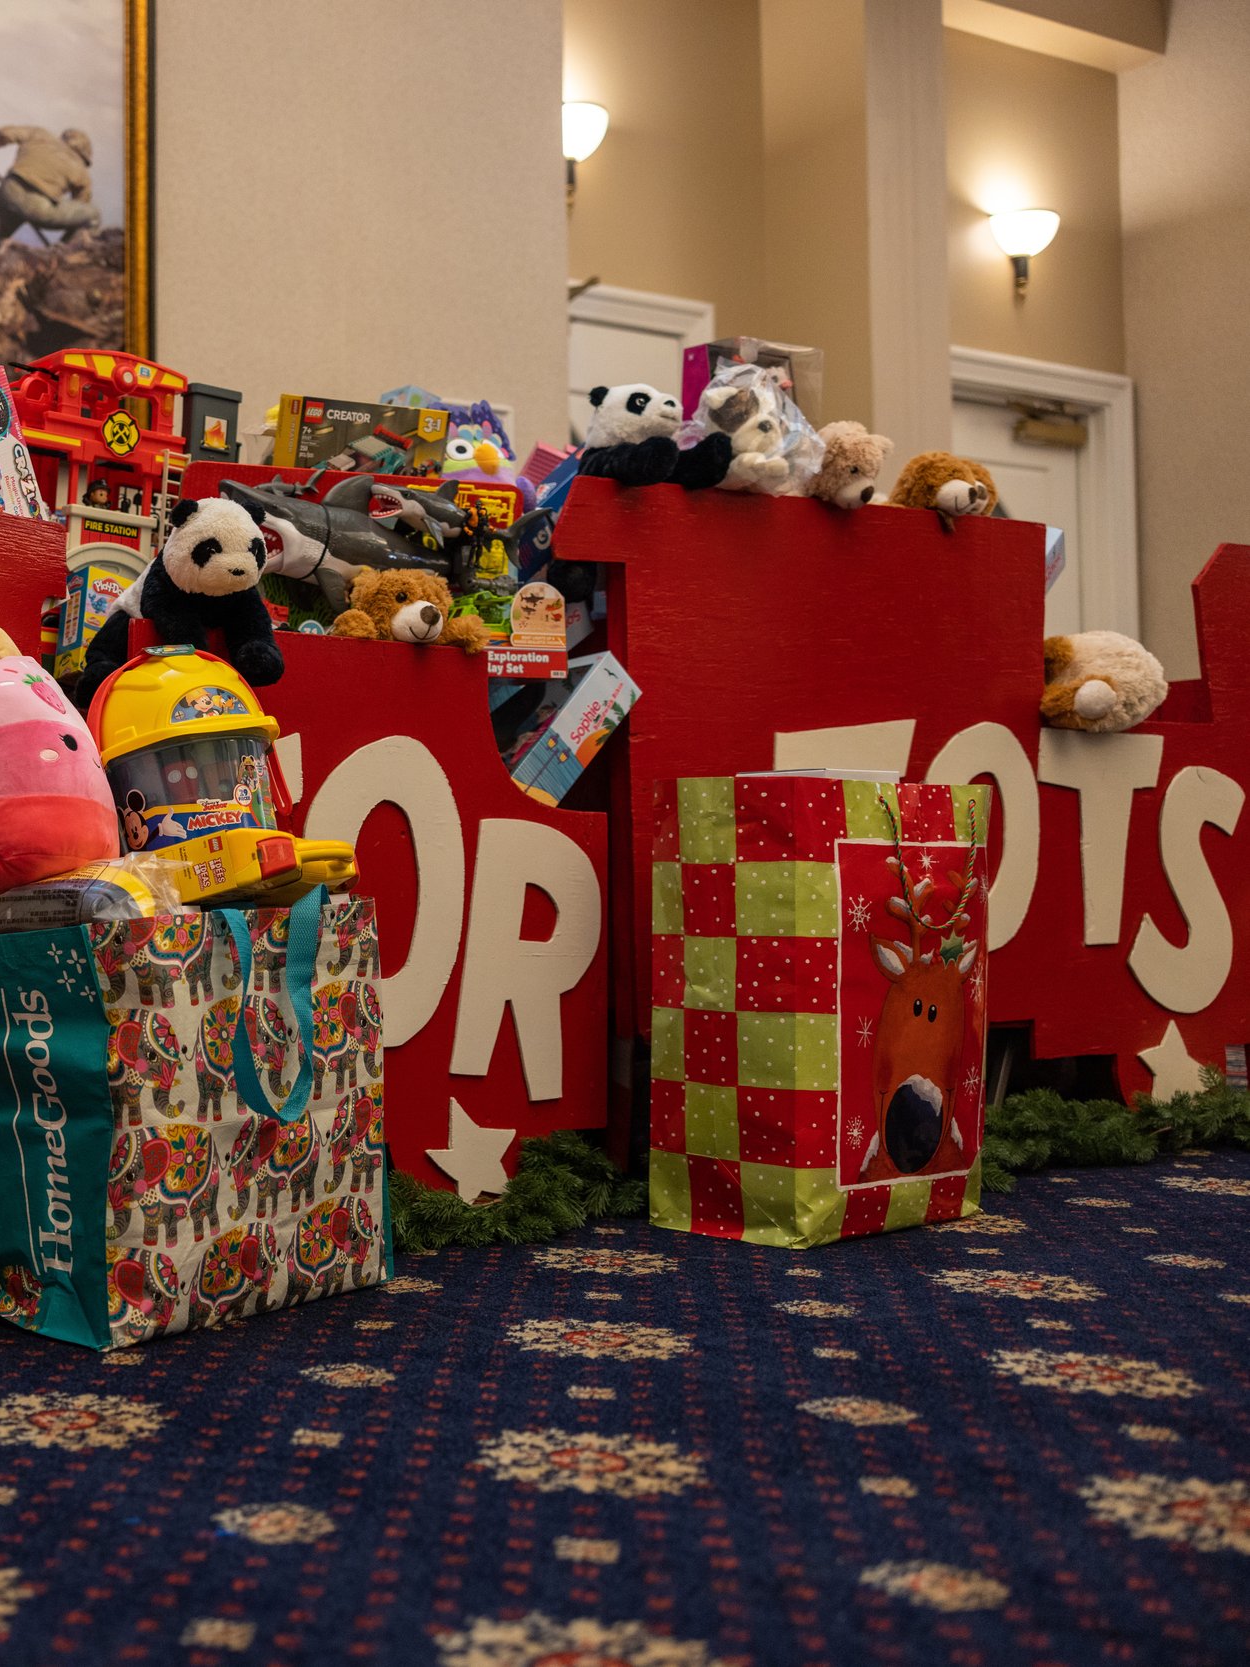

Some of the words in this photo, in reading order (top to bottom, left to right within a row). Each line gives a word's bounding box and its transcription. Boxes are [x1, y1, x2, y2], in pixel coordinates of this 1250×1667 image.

[306, 407, 323, 417] LEGO
[326, 409, 371, 423] CREATOR
[302, 427, 312, 435] 7+
[84, 519, 103, 533] FIRE
[104, 523, 138, 537] STATION
[93, 579, 124, 596] Play-Do
[487, 651, 550, 665] Exploration
[506, 663, 524, 674] Set
[569, 699, 602, 745] Sophie
[187, 810, 242, 830] MICKEY
[199, 862, 211, 888] IDEAS
[274, 732, 604, 1104] OR
[772, 716, 1246, 1015] OTS
[12, 988, 75, 1278] HomeGoods
